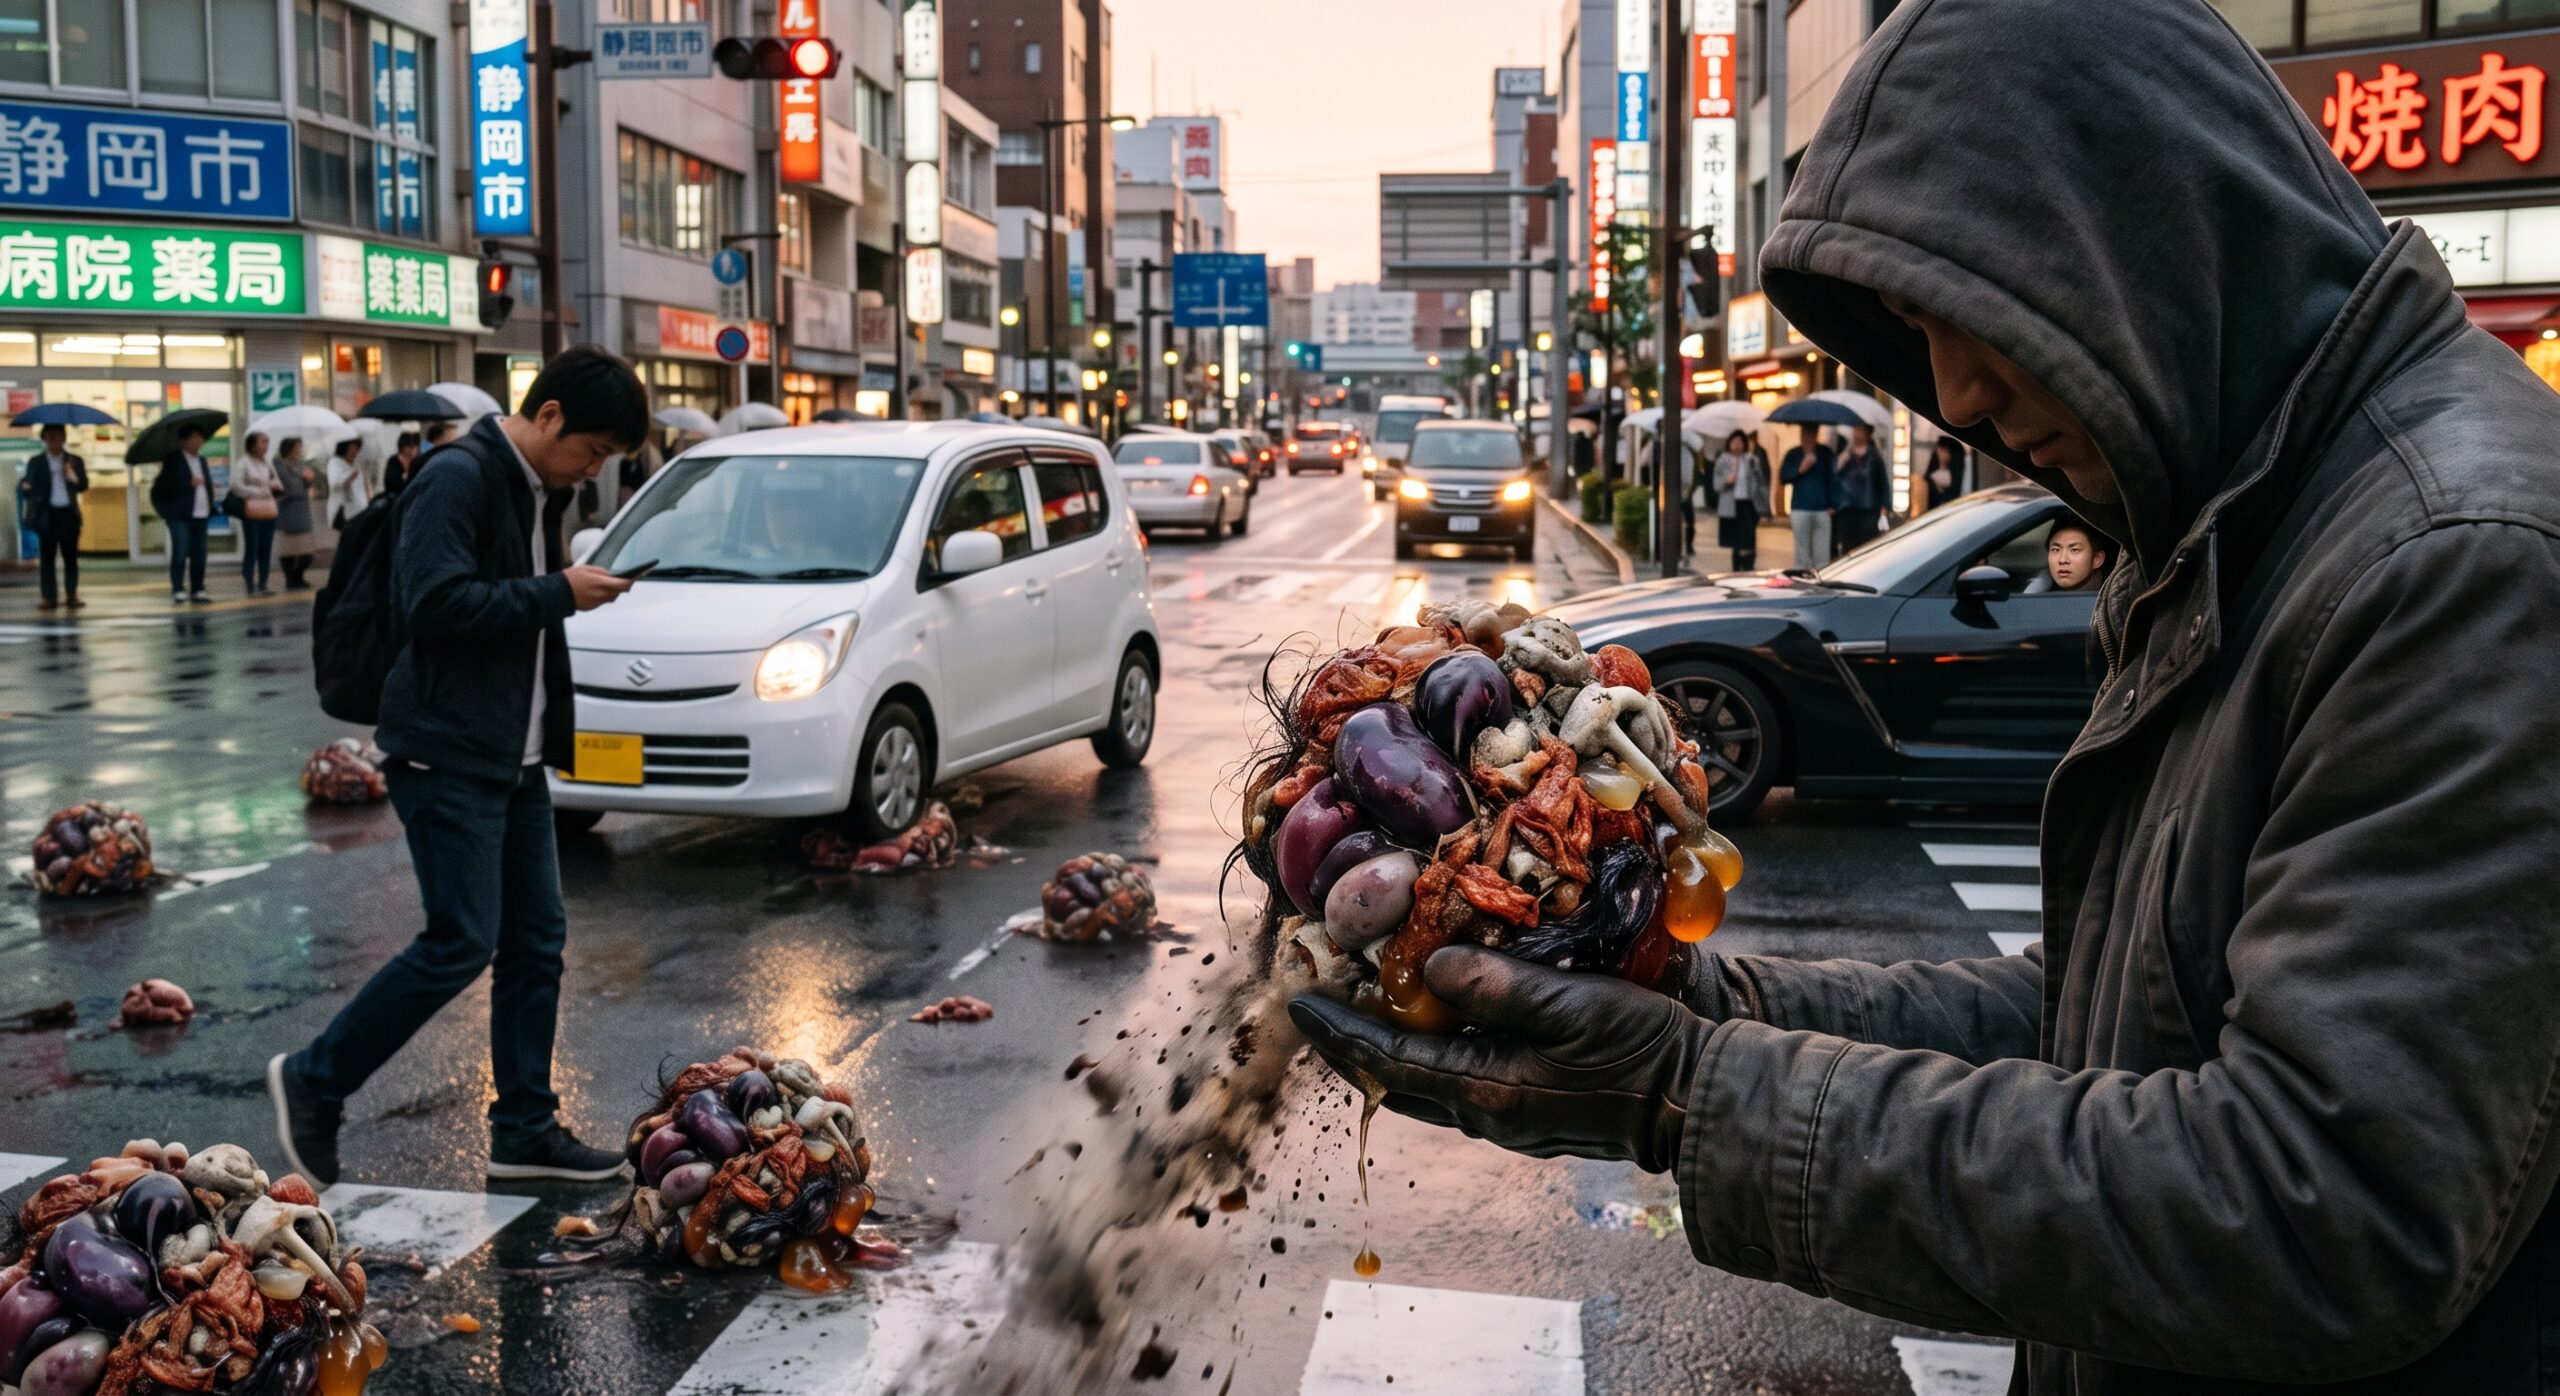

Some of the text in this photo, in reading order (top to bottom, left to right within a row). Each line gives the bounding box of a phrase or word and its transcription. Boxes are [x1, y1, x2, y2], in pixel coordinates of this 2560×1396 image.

[0, 114, 265, 206] 静岡市
[478, 64, 525, 220] 静岡市
[2322, 52, 2546, 172] 焼肉
[0, 230, 134, 301] 病院
[152, 236, 287, 306] 薬局
